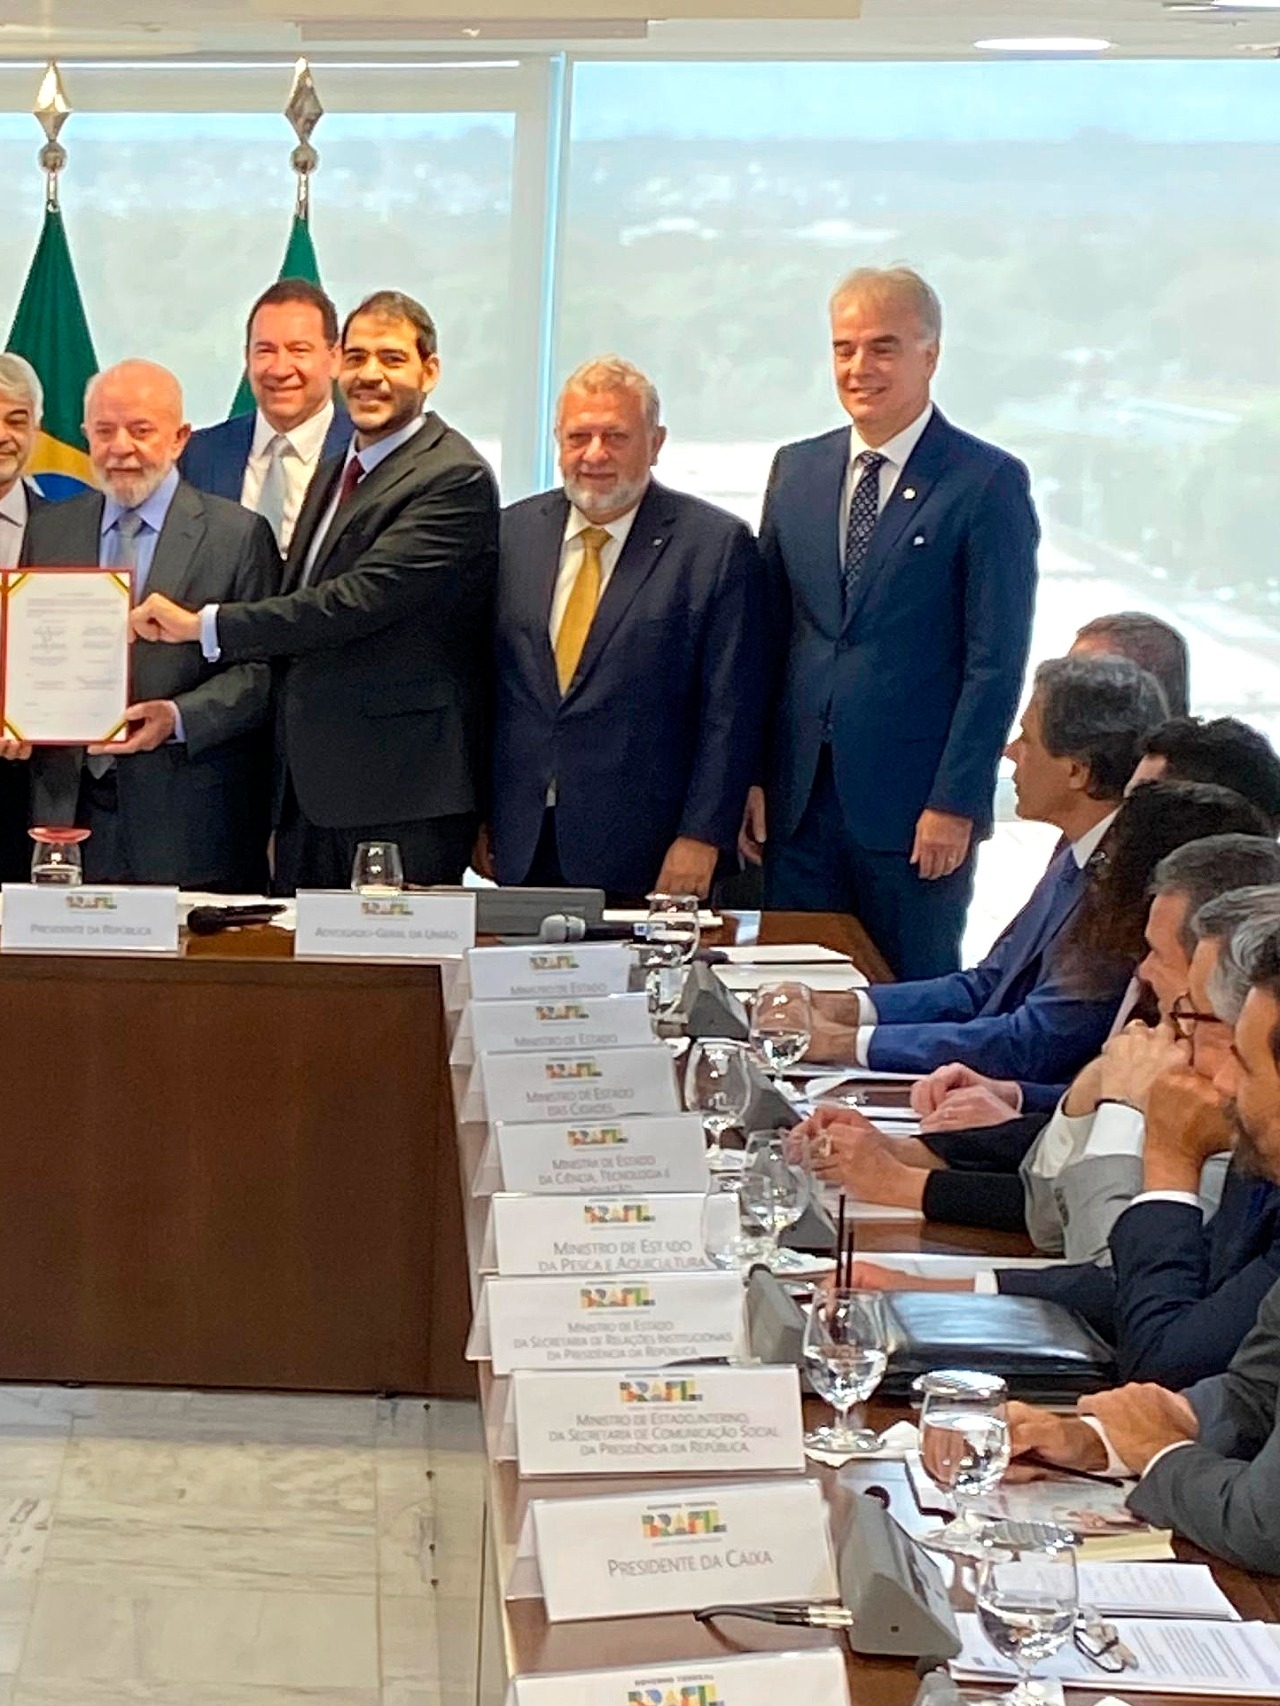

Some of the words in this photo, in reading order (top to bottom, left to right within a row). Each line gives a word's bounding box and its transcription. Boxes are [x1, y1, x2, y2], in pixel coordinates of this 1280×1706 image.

[553, 1240, 618, 1256] MINISTRO
[620, 1241, 636, 1254] DE
[538, 1261, 558, 1273] DA
[561, 1257, 602, 1272] PESCA
[616, 1321, 632, 1332] DE
[634, 1320, 674, 1332] ESTADO
[514, 1338, 530, 1350] DA
[546, 1350, 562, 1361] DA
[576, 1414, 631, 1427] MINISTRO
[633, 1414, 648, 1426] DE
[548, 1430, 564, 1442] DA
[568, 1426, 632, 1441] SECRETARIA
[634, 1428, 648, 1440] DE
[652, 1426, 737, 1440] COMUNICAÇÃO
[740, 1424, 779, 1438] SOCIAL
[580, 1444, 596, 1456] DA
[670, 1443, 687, 1454] DA
[690, 1440, 750, 1454] REPÚBLICA
[607, 1556, 696, 1577] PRESIDENTE
[700, 1554, 722, 1570] DA
[725, 1549, 774, 1568] CAIXA
